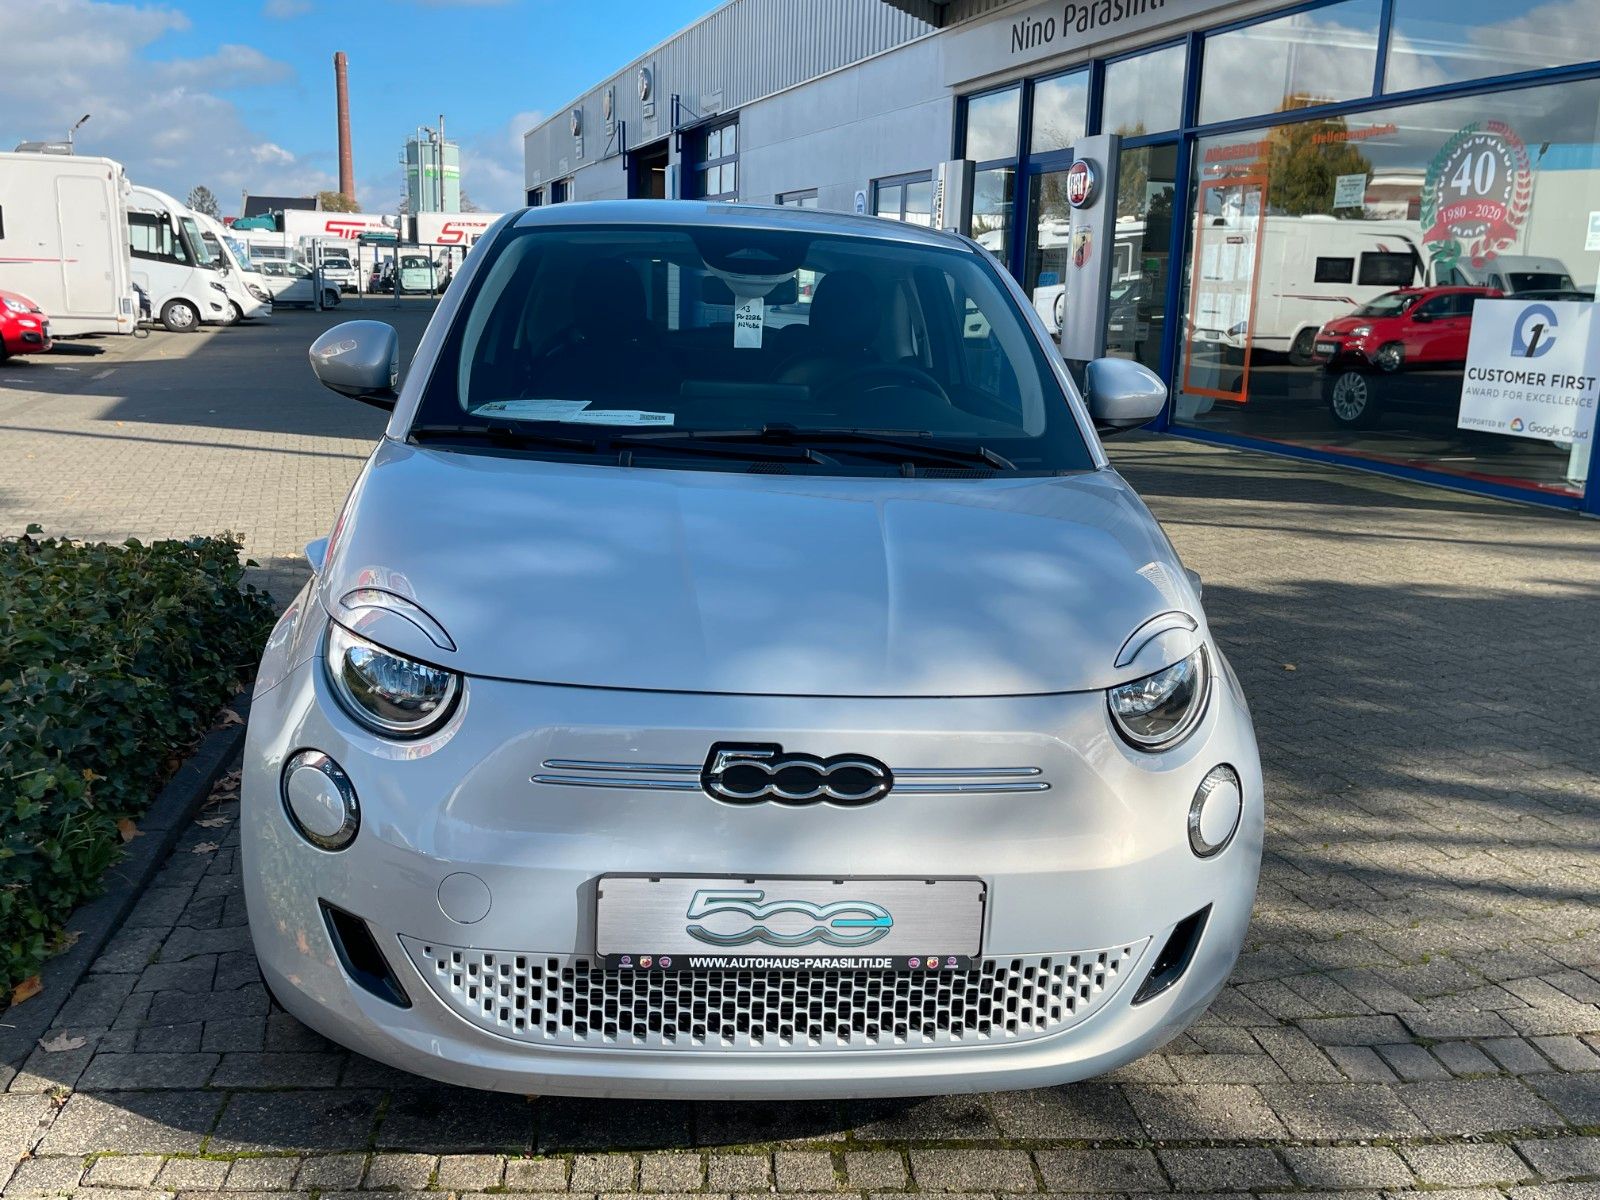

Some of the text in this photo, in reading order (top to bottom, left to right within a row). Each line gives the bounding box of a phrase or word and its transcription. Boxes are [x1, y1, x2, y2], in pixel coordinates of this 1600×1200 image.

[1011, 0, 1165, 54] Nino Parasi
[1450, 150, 1496, 196] 40
[1442, 206, 1467, 223] 1980
[1475, 204, 1502, 221] 2020
[1468, 367, 1596, 391] CUSTOMER FIRST
[1465, 387, 1593, 408] AWARD FOR EXCELLENCE
[1461, 416, 1589, 440] SUPPORTED BY Google Cloud
[708, 748, 887, 801] 500
[689, 957, 893, 969] WWW.AUTOHAUS-PARASILITI.DE
